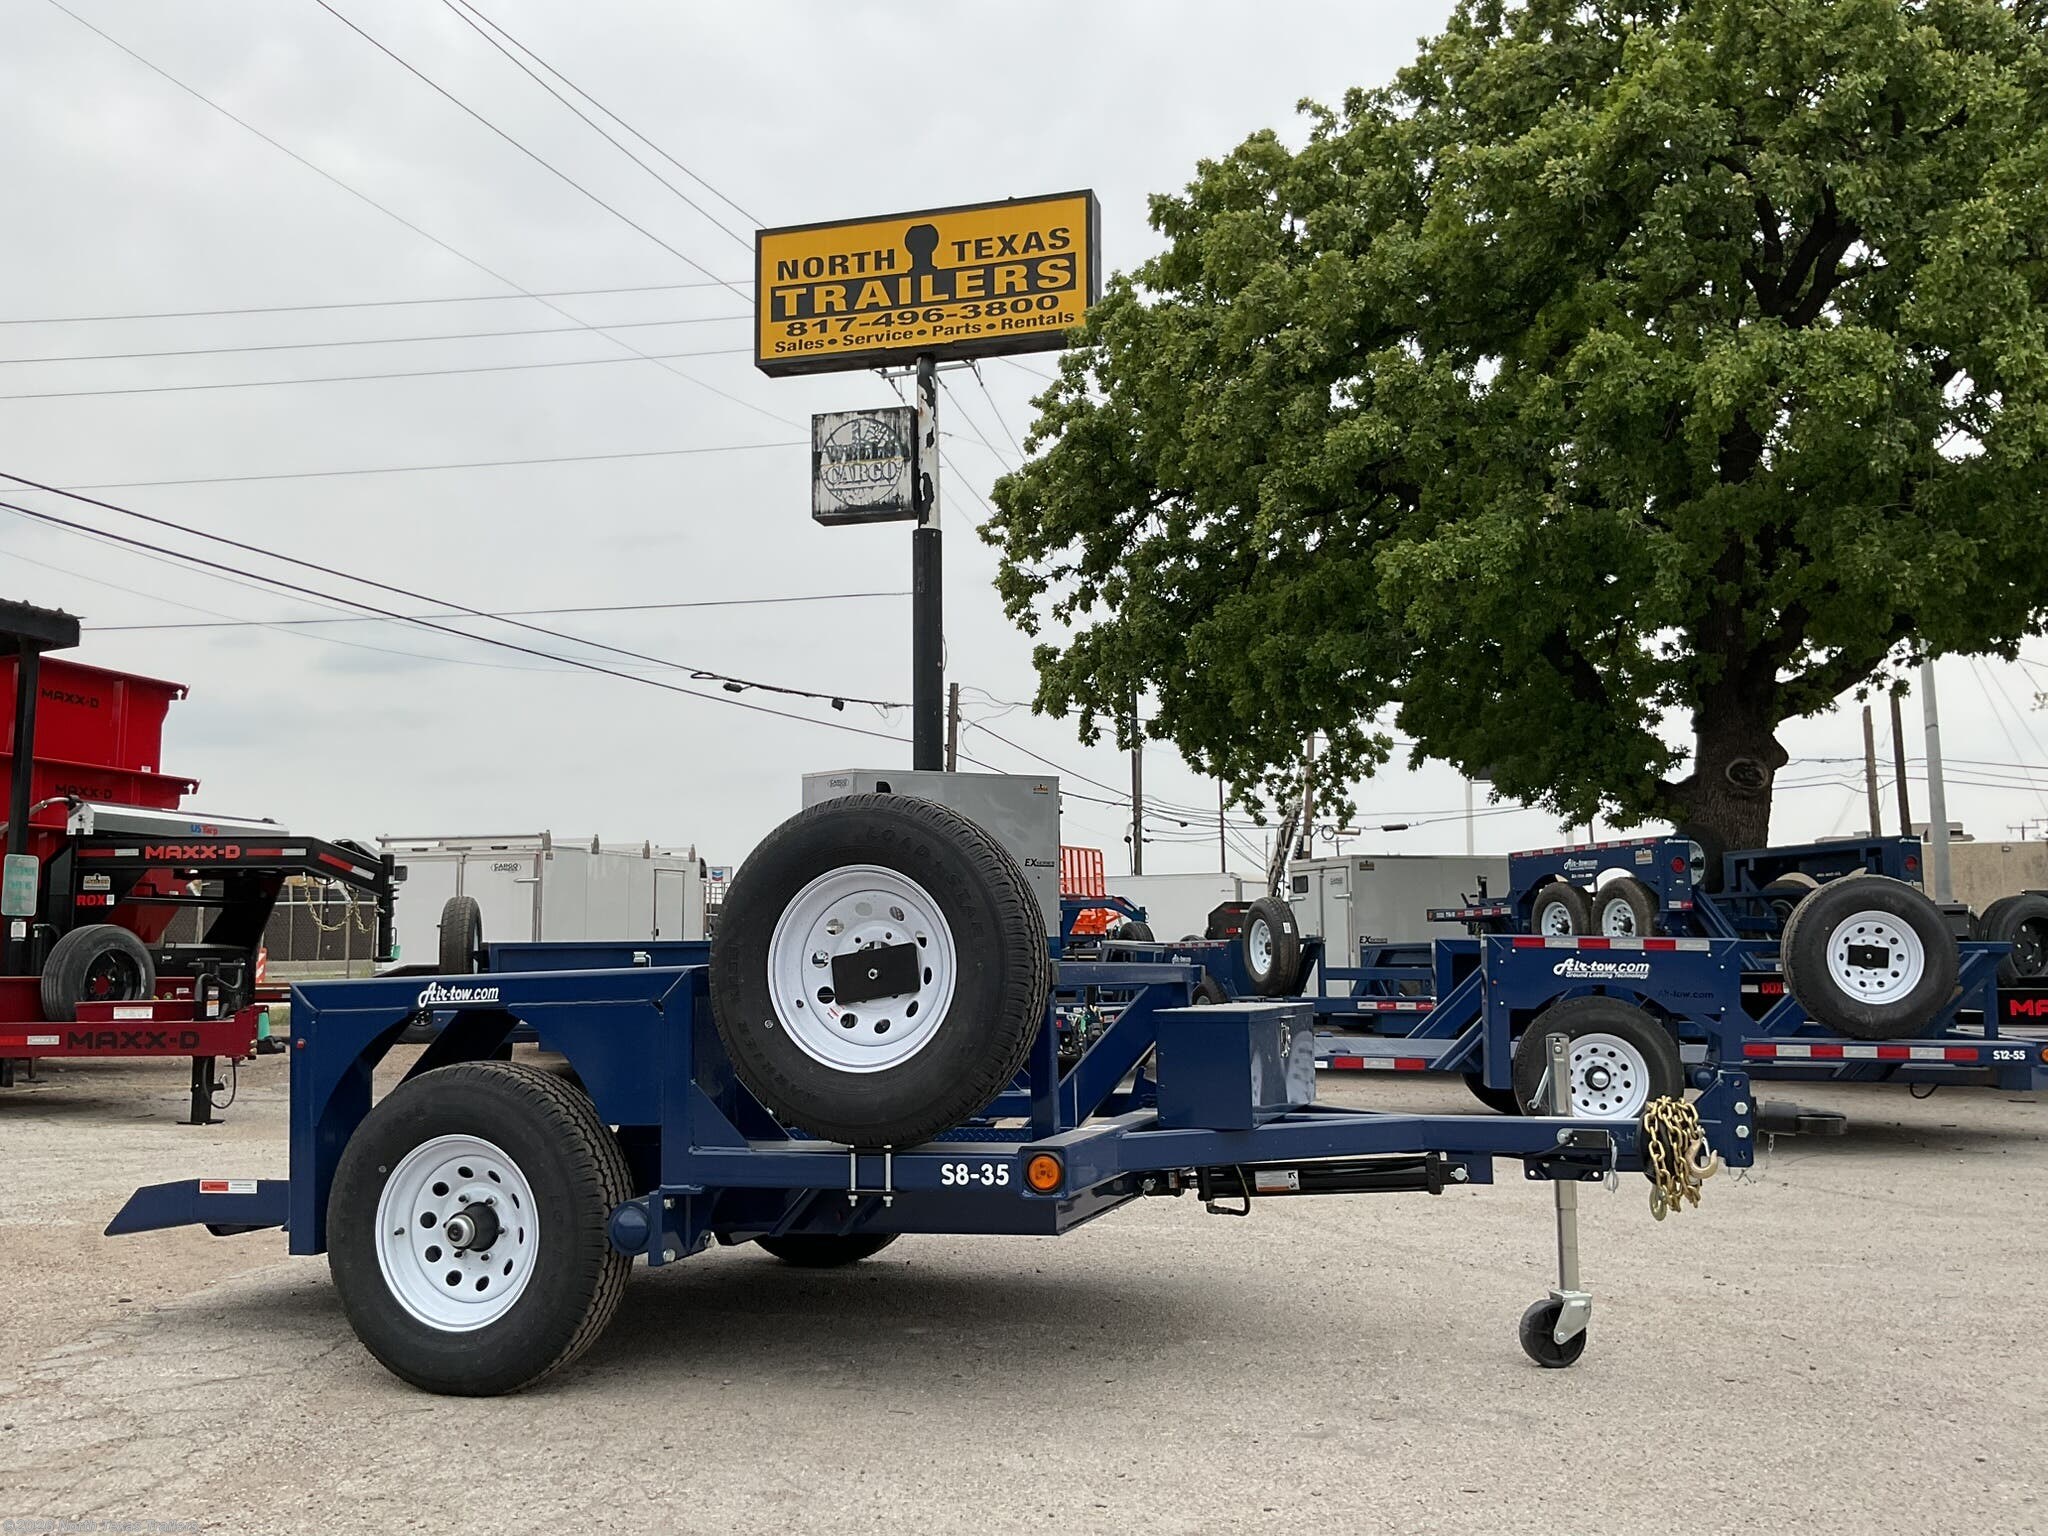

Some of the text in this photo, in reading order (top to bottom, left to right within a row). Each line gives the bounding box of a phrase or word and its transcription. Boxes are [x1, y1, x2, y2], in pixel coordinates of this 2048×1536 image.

[777, 227, 1071, 281] NORTH TEXAS
[775, 258, 1072, 317] TRAILERS
[786, 295, 1059, 337] 817-496-3800
[775, 311, 1075, 353] Sales Service Parts Rentals
[826, 461, 897, 485] CARGO
[41, 687, 99, 708] MAXX-D
[55, 783, 112, 800] MAXX-D
[144, 845, 241, 859] MAXX-D
[1553, 958, 1650, 975] Air-tow.com
[418, 981, 499, 1008] Air-tow.com
[68, 1031, 200, 1050] MAXX-D
[1993, 1050, 2026, 1060] S12-55
[940, 1163, 1010, 1186] S8-35
